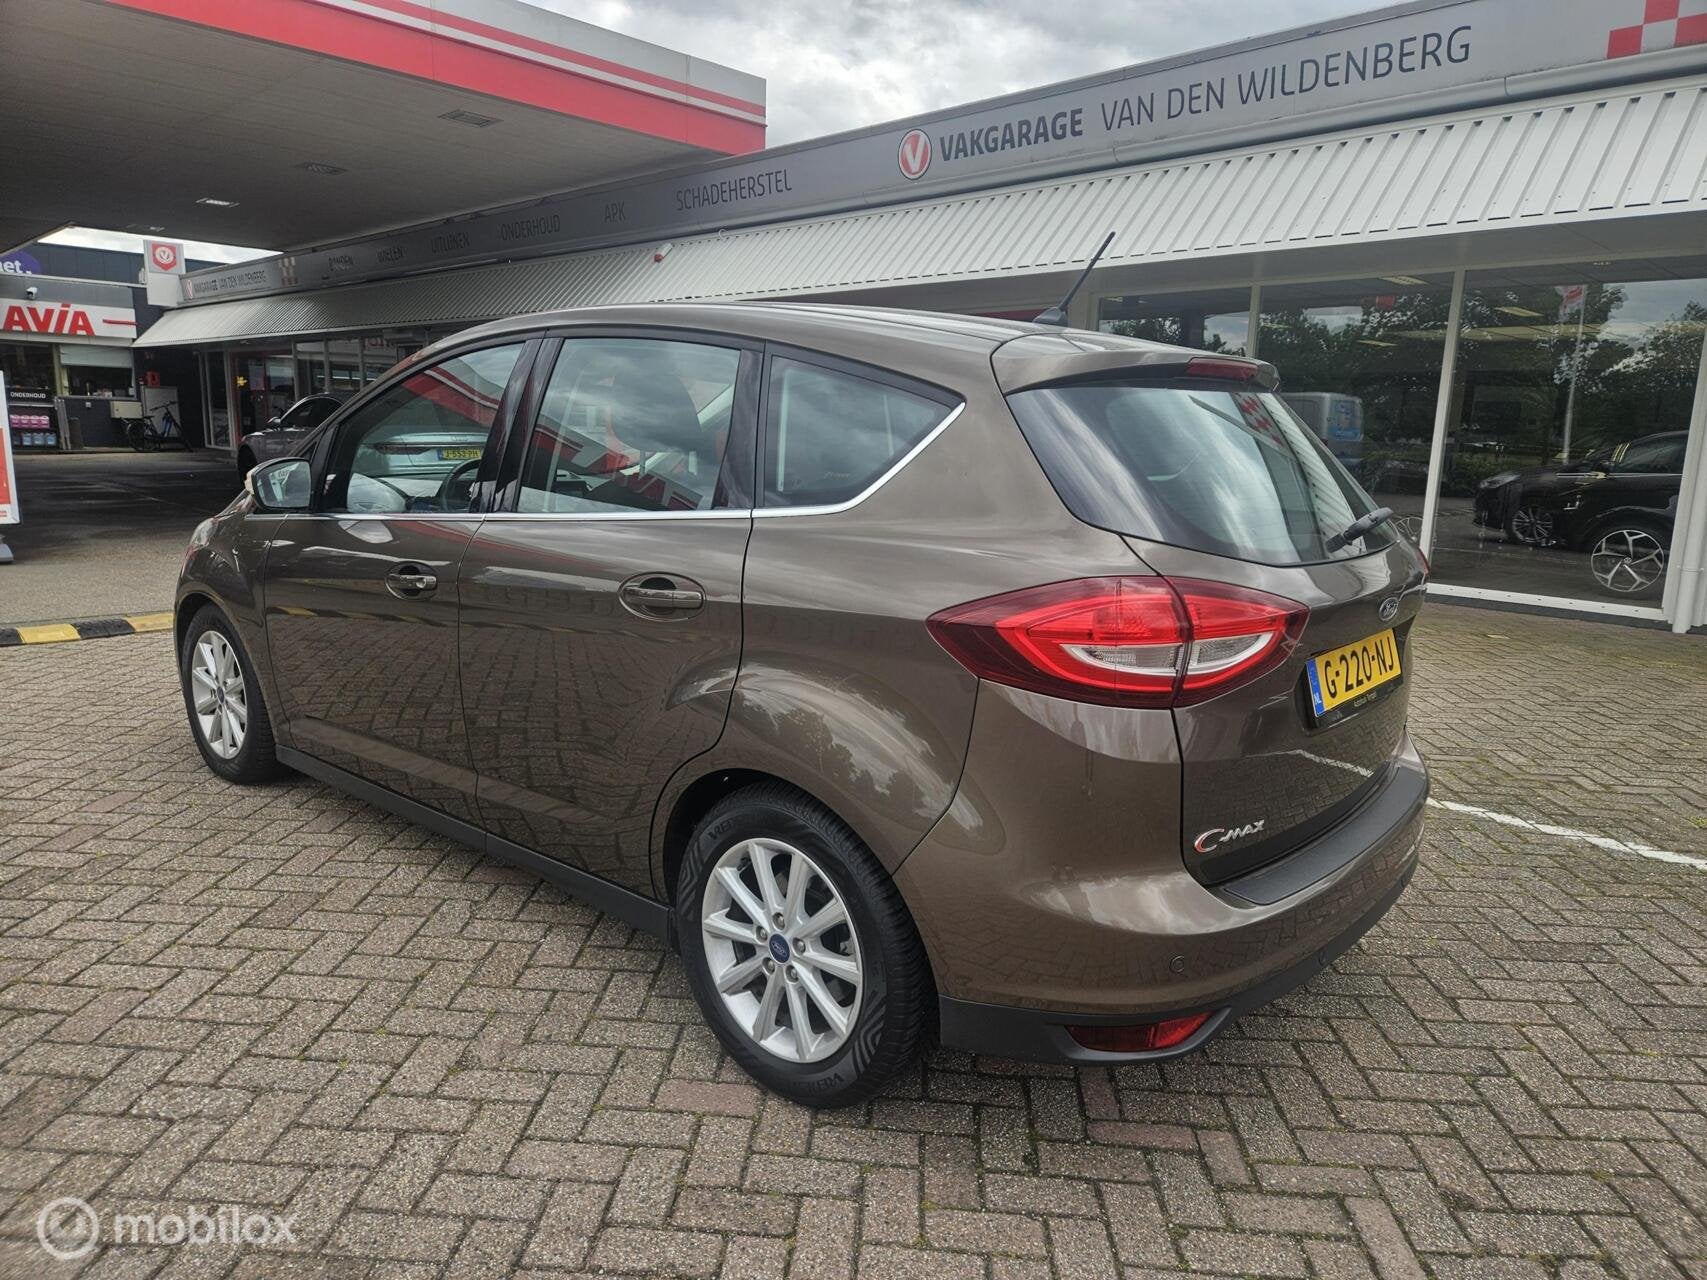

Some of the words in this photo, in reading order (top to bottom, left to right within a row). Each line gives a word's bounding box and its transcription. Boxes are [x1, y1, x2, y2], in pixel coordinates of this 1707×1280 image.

[939, 107, 1083, 162] VAKGARAGE
[1101, 93, 1154, 131] VAN
[1166, 77, 1225, 120] DEN
[1237, 25, 1472, 105] WILDENBERG
[501, 214, 561, 241] ONDERHOUD
[604, 202, 626, 223] APK
[675, 169, 793, 212] SCHADEHERSTEL
[3, 303, 96, 337] AVIA
[10, 391, 46, 399] ONDERHOUD
[1324, 636, 1395, 699] G-220-NJ
